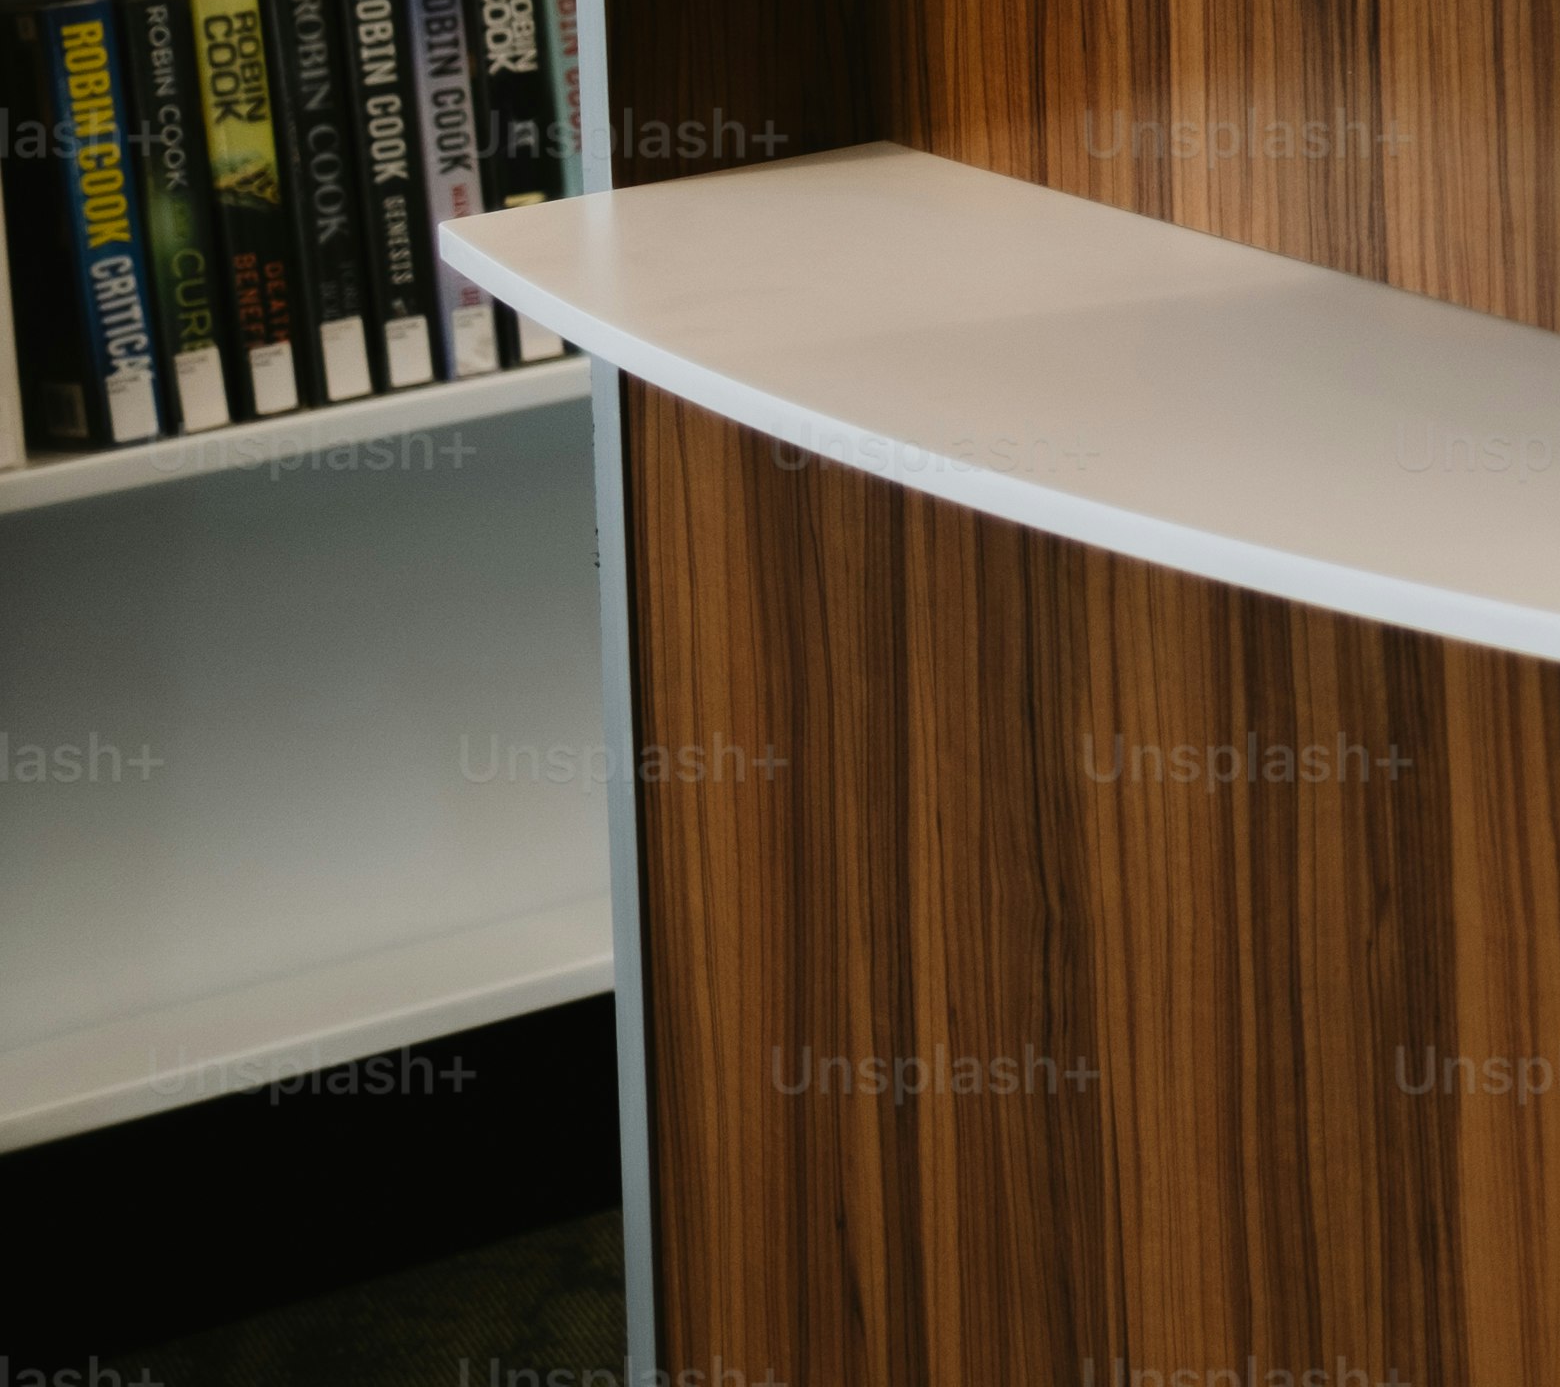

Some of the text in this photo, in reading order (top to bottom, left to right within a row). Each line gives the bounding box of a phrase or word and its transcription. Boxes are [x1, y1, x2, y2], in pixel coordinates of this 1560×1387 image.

[60, 21, 116, 130] ROBIN
[145, 5, 188, 188] ROBIN COOK
[203, 16, 245, 124] COOK
[231, 10, 269, 123] ROBIN
[364, 96, 408, 183] COOK
[430, 87, 473, 174] COOK
[75, 137, 131, 249] COOK
